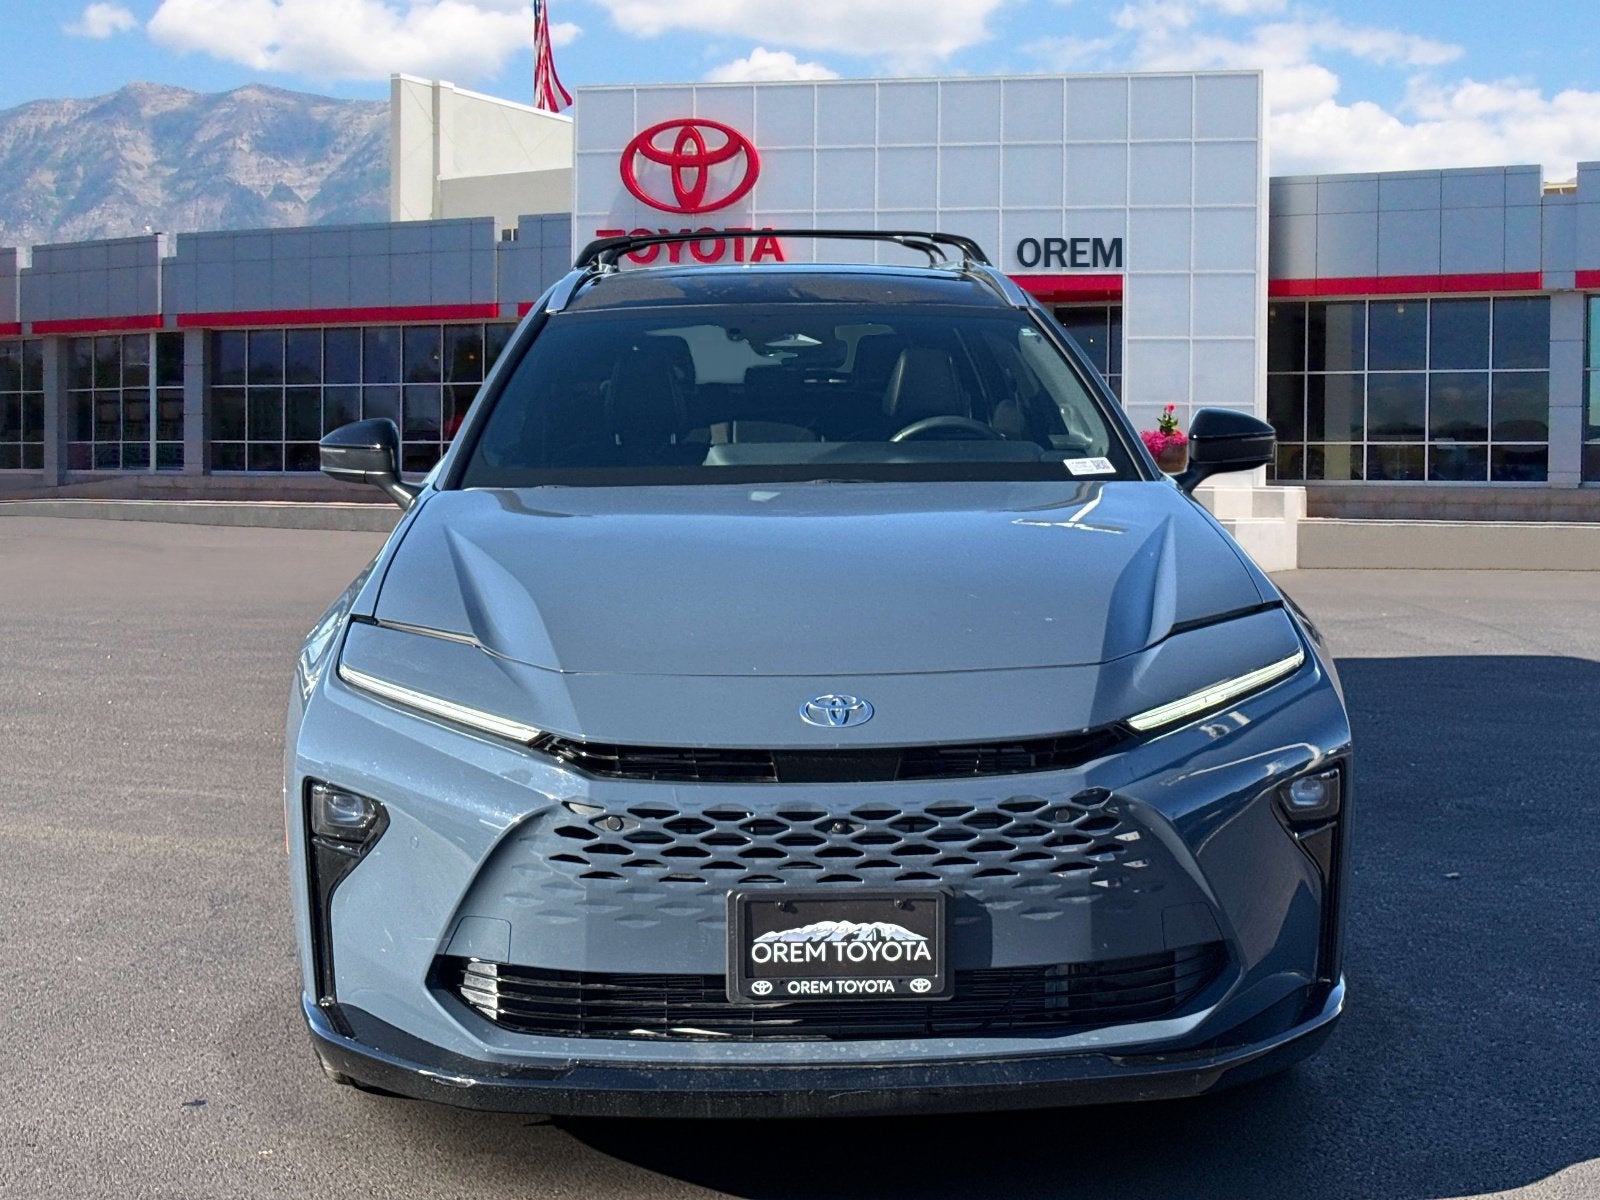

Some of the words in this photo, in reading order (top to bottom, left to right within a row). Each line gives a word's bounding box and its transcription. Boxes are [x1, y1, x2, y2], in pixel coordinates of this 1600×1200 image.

[1016, 237, 1123, 268] OREM
[751, 942, 826, 964] OREM
[832, 941, 932, 962] TOYOTA
[787, 981, 833, 994] OREM
[835, 979, 895, 993] TOYOTA
